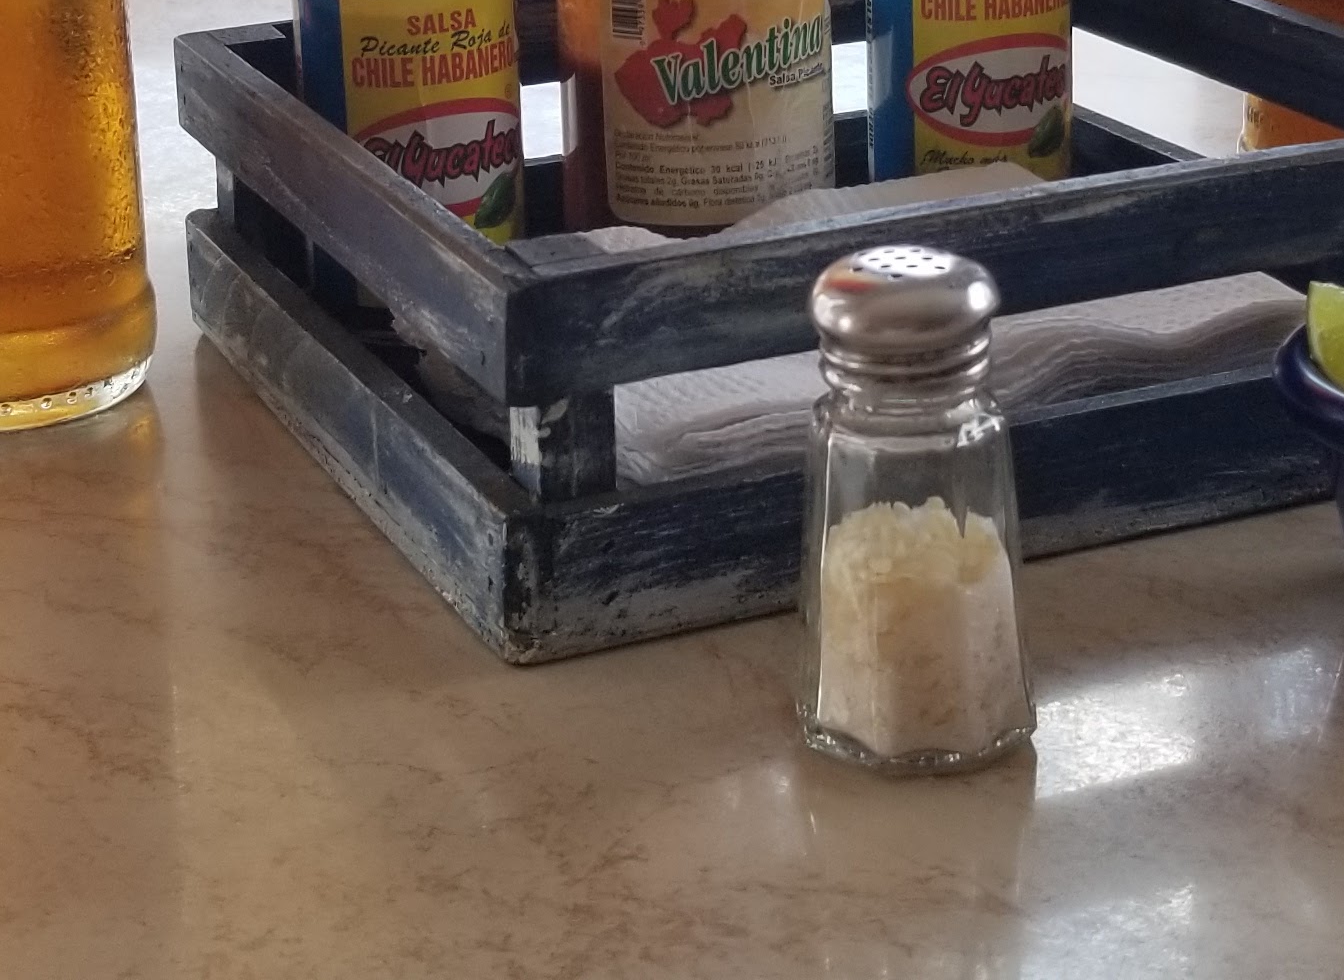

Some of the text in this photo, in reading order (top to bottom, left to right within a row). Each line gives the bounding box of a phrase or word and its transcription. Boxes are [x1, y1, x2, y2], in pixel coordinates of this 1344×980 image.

[360, 20, 510, 58] Picante Roja de
[407, 7, 477, 36] SALSA
[351, 36, 514, 89] CHILE HABANERO
[652, 13, 824, 104] Valentina
[769, 69, 797, 86] Salsa
[919, 54, 1066, 127] El Yucatec
[400, 118, 521, 189] Yucatec
